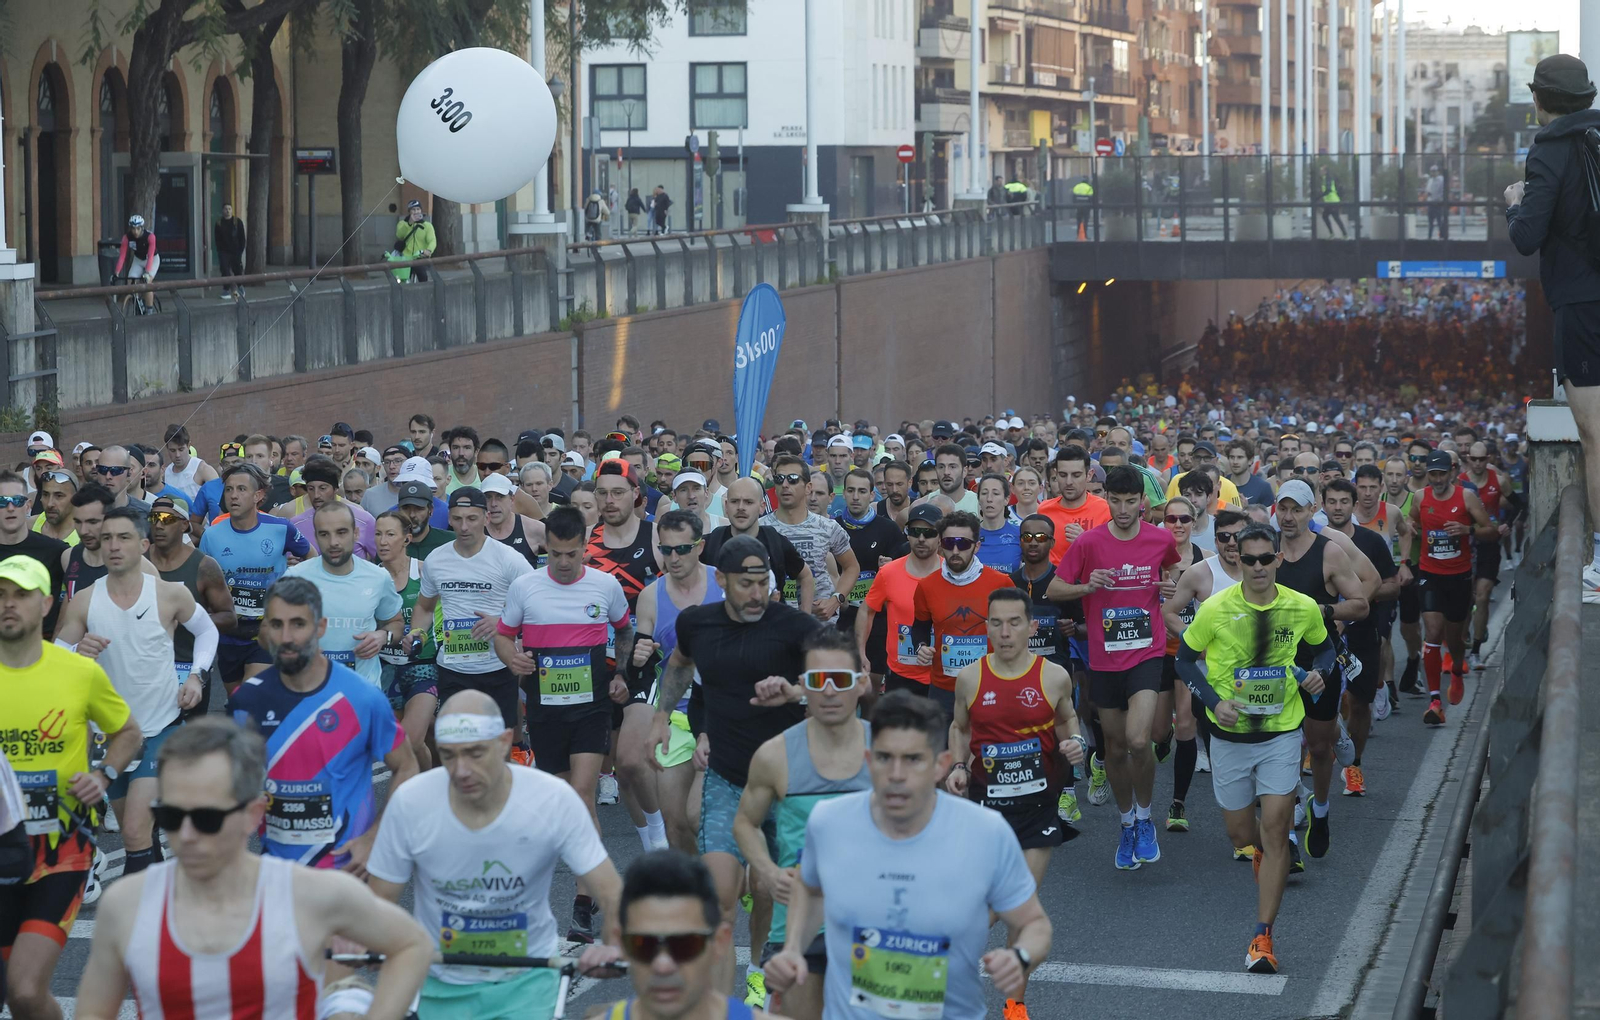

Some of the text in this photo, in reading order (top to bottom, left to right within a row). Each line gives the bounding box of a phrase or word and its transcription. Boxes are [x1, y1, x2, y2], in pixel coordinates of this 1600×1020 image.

[430, 87, 472, 133] 3:00
[232, 596, 256, 607] PONCE
[1116, 629, 1140, 640] ALEX
[444, 642, 490, 653] RUI RAMOS
[556, 658, 584, 666] ZURICH
[551, 682, 580, 692] DAVID
[1249, 694, 1274, 704] PACO
[1001, 742, 1034, 754] ZURICH
[1004, 760, 1022, 770] 2986
[996, 769, 1034, 784] ÓSCAR
[280, 784, 322, 793] ZURICH
[294, 814, 333, 830] MASSÓ
[470, 919, 518, 929] ZURICH
[886, 935, 939, 953] ZURICH
[852, 975, 944, 1002] MARCOS JUNIOR
